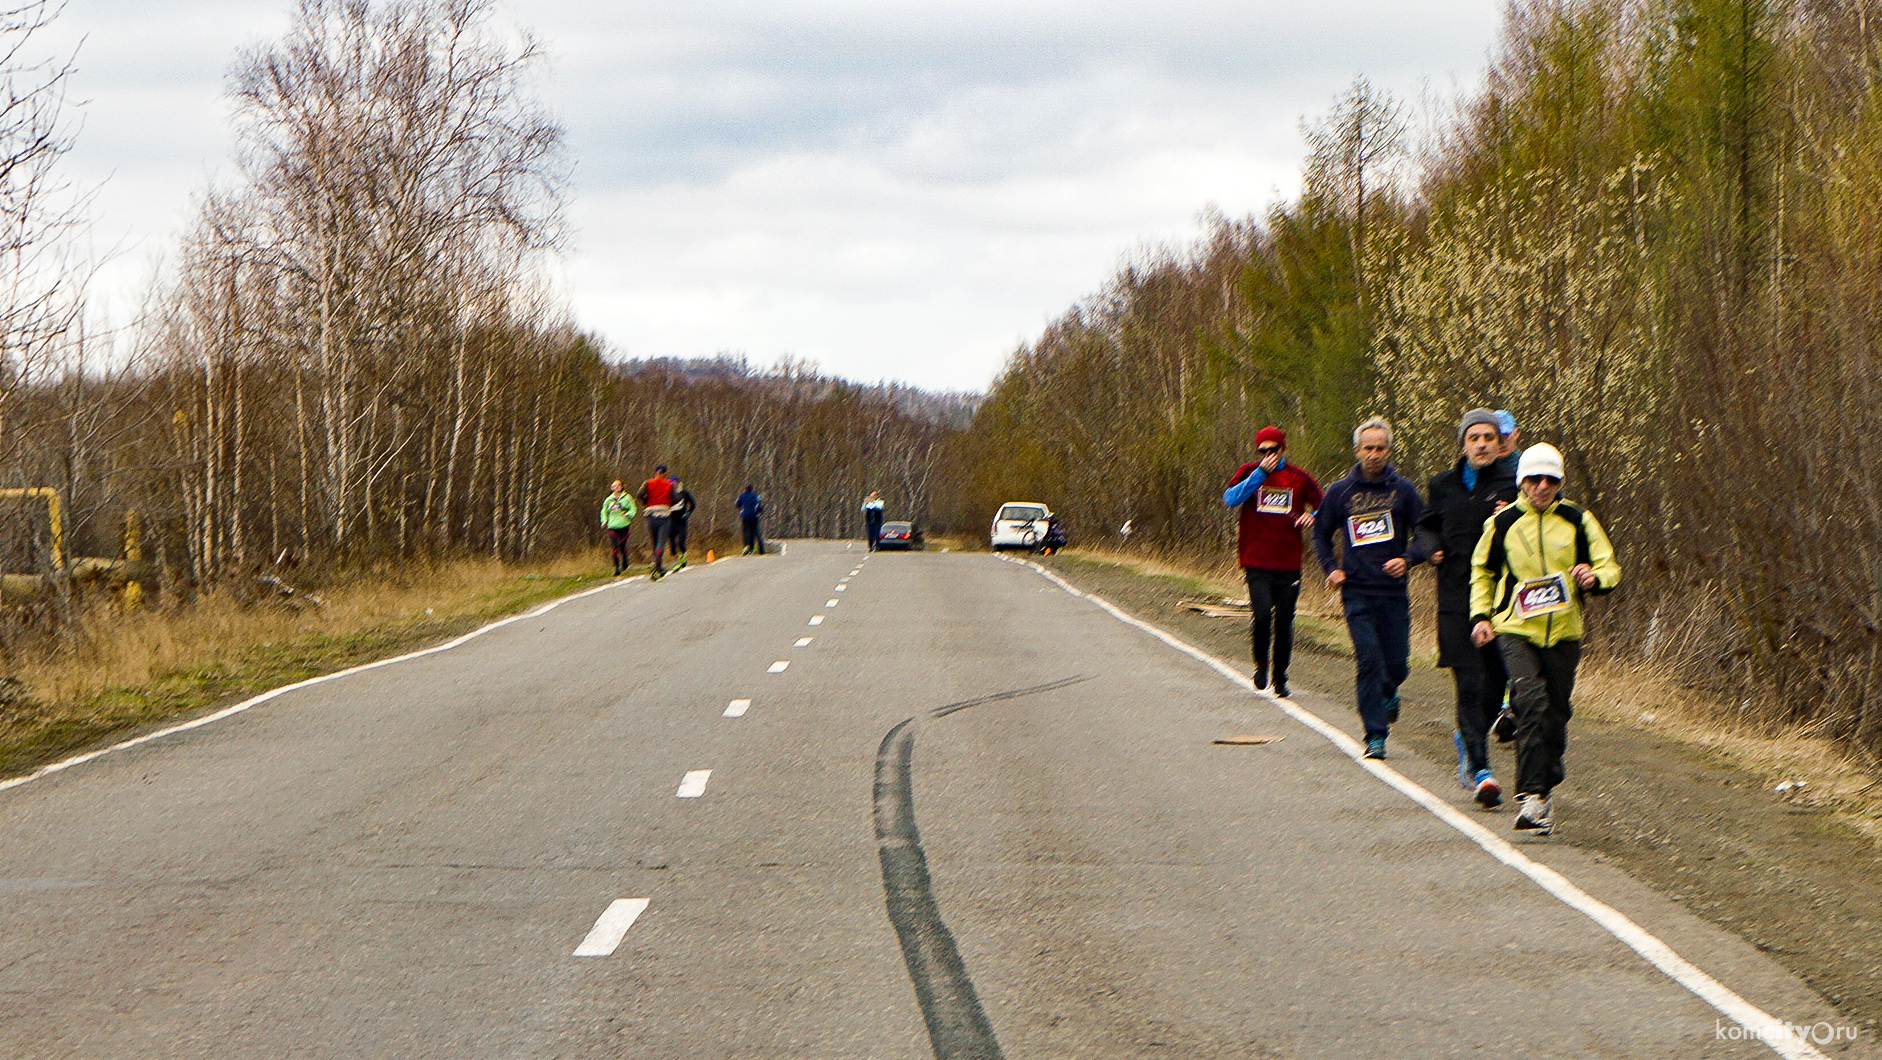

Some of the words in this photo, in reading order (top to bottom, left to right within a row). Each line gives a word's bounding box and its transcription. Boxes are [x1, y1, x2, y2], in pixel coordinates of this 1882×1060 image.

[1263, 493, 1288, 507] 422
[1356, 521, 1387, 535] 424
[1523, 586, 1561, 606] 423
